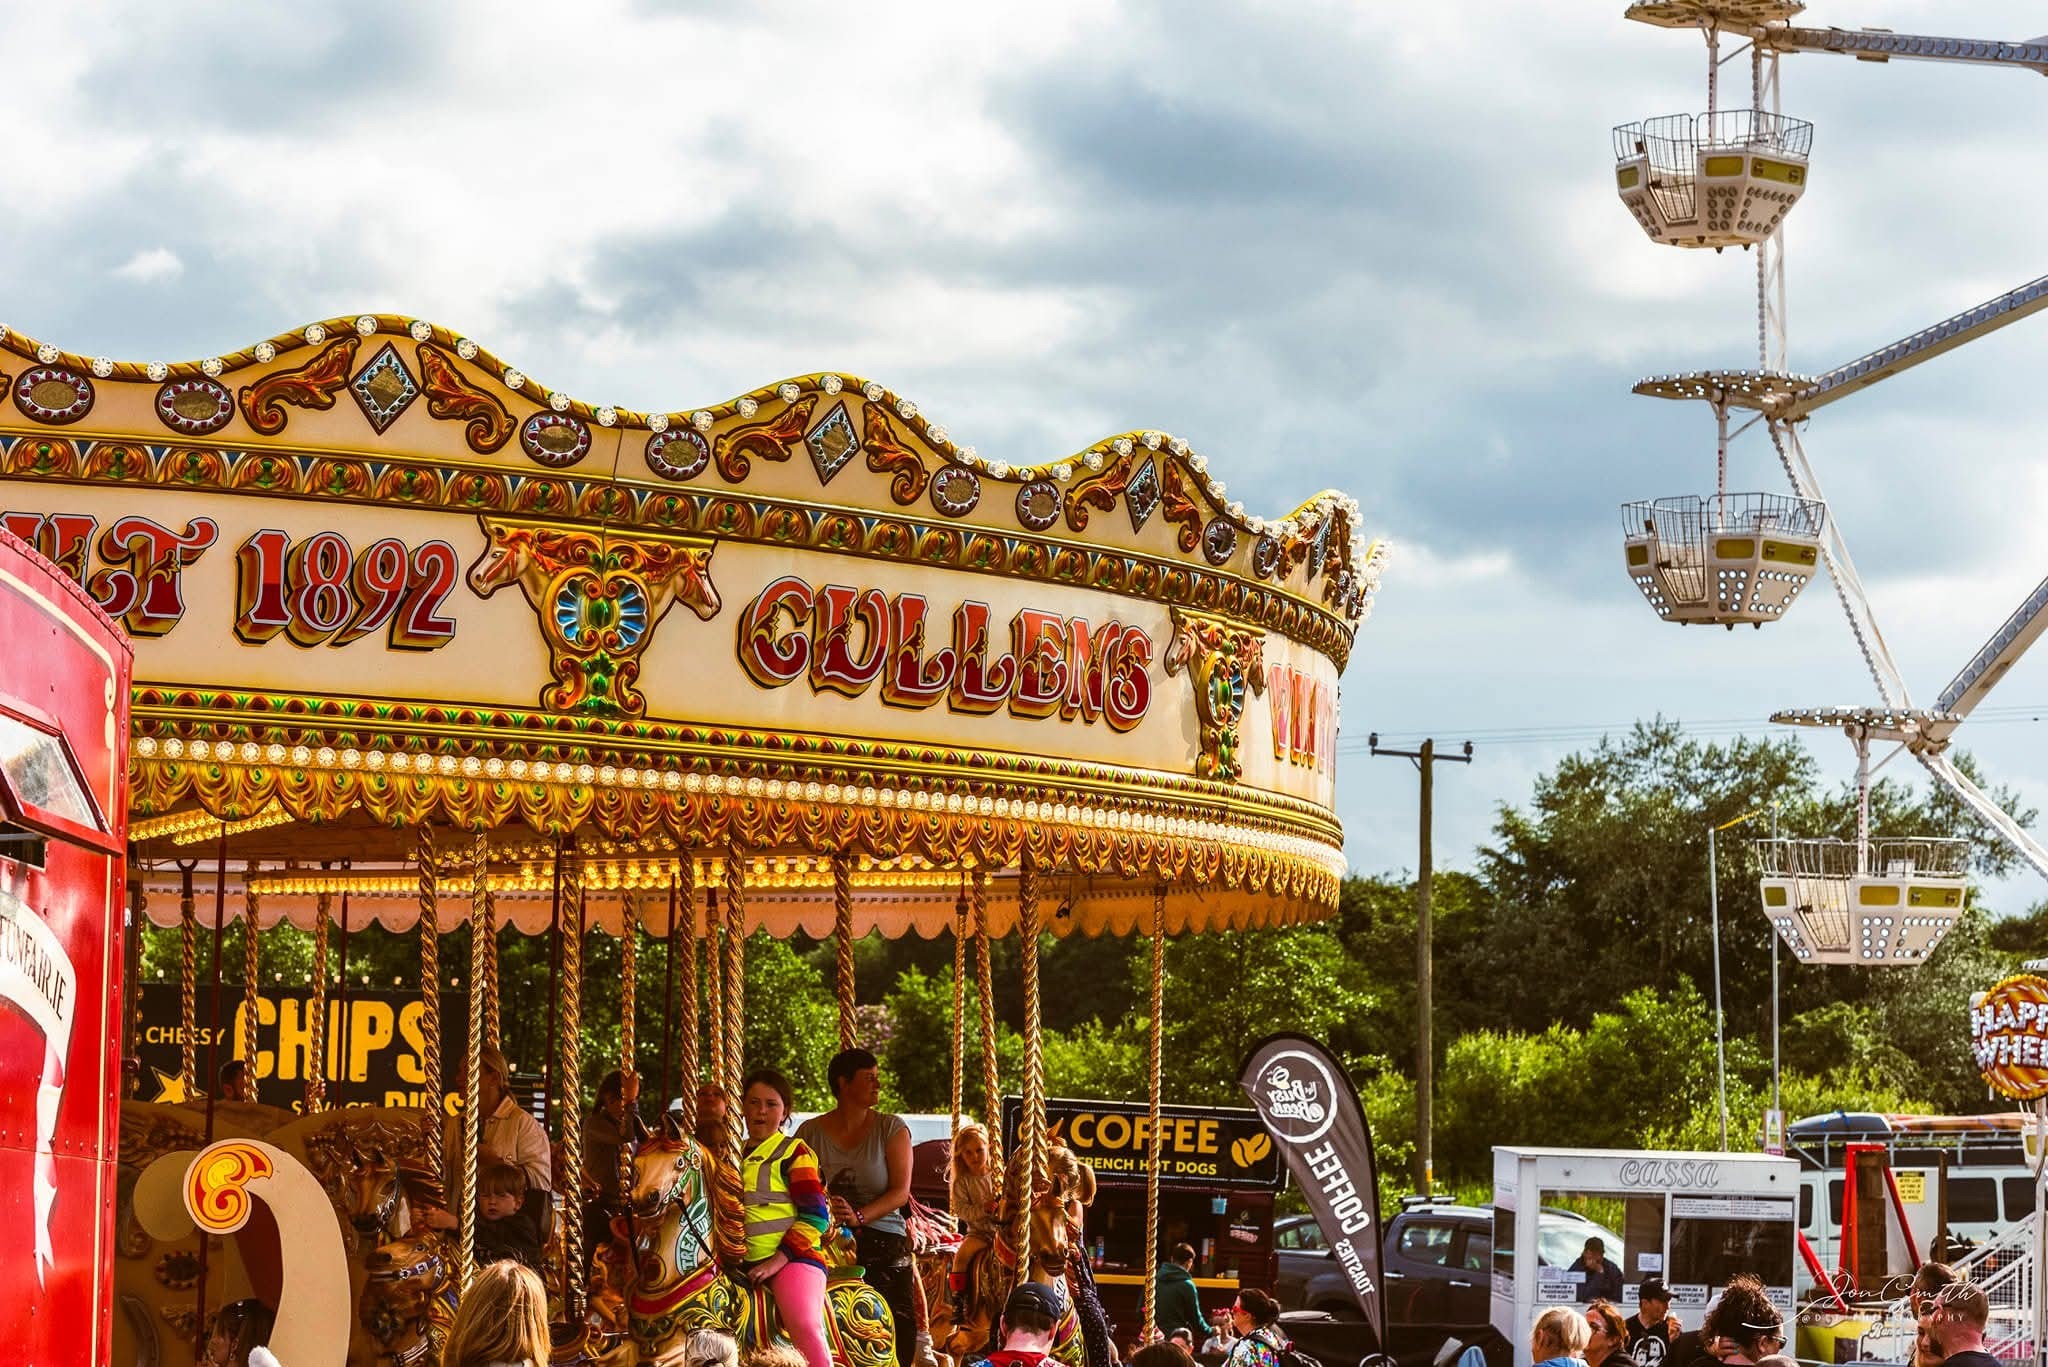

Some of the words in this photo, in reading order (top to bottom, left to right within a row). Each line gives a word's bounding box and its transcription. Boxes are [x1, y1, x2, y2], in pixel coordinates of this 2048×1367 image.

[232, 528, 460, 652] 1892
[736, 575, 1154, 733] CULLENS
[233, 996, 426, 1084] CHIPS
[1070, 1113, 1219, 1154] COFFEE
[1078, 1157, 1134, 1171] FRENCH
[1139, 1159, 1171, 1172] HT
[1175, 1161, 1217, 1176] DOGS
[1620, 1159, 1719, 1188] cassa
